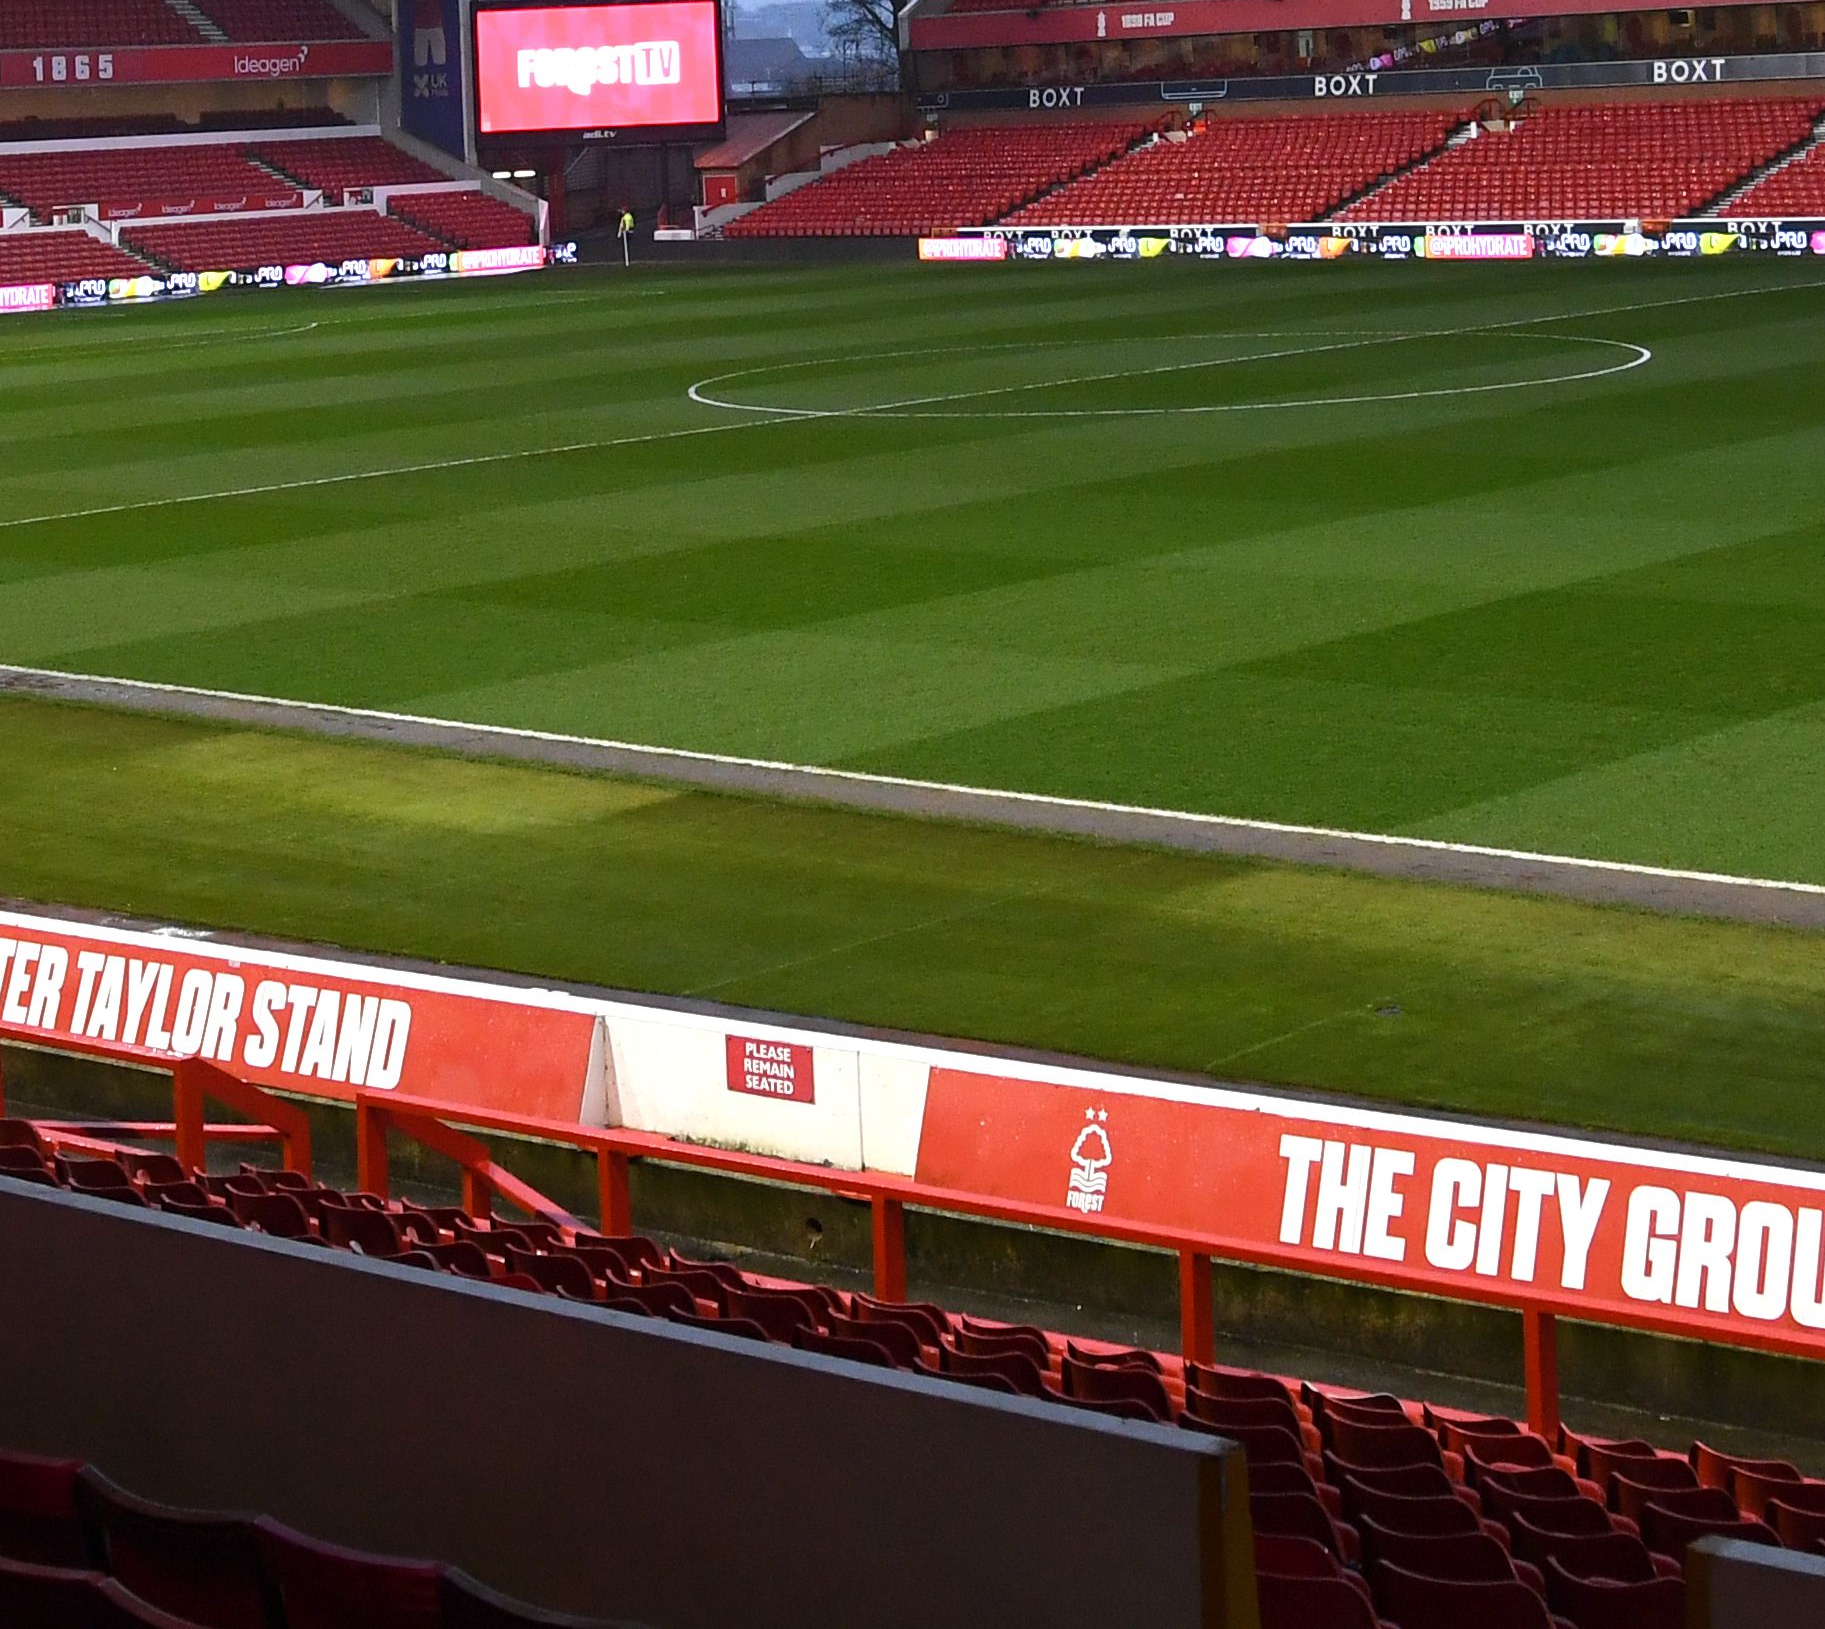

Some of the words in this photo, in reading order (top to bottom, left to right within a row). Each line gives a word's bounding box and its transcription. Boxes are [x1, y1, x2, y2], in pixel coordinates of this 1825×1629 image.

[33, 53, 114, 81] 1865
[234, 54, 300, 77] Ideagen
[642, 48, 673, 79] TV
[1654, 59, 1726, 82] BOXT
[1314, 75, 1378, 96] BOXT
[1030, 87, 1085, 108] BOXT
[108, 207, 139, 218] Ideagen
[161, 204, 192, 215] Ideagen
[214, 201, 244, 212] Ideagen
[264, 198, 295, 209] Ideagen
[71, 950, 245, 1061] TAYLOR
[244, 980, 412, 1090] STAND
[745, 1042, 792, 1062] PLEASE
[743, 1058, 794, 1078] REMAIN
[745, 1074, 794, 1095] SEATED
[1279, 1133, 1416, 1262] THE
[1424, 1157, 1612, 1290] CITY
